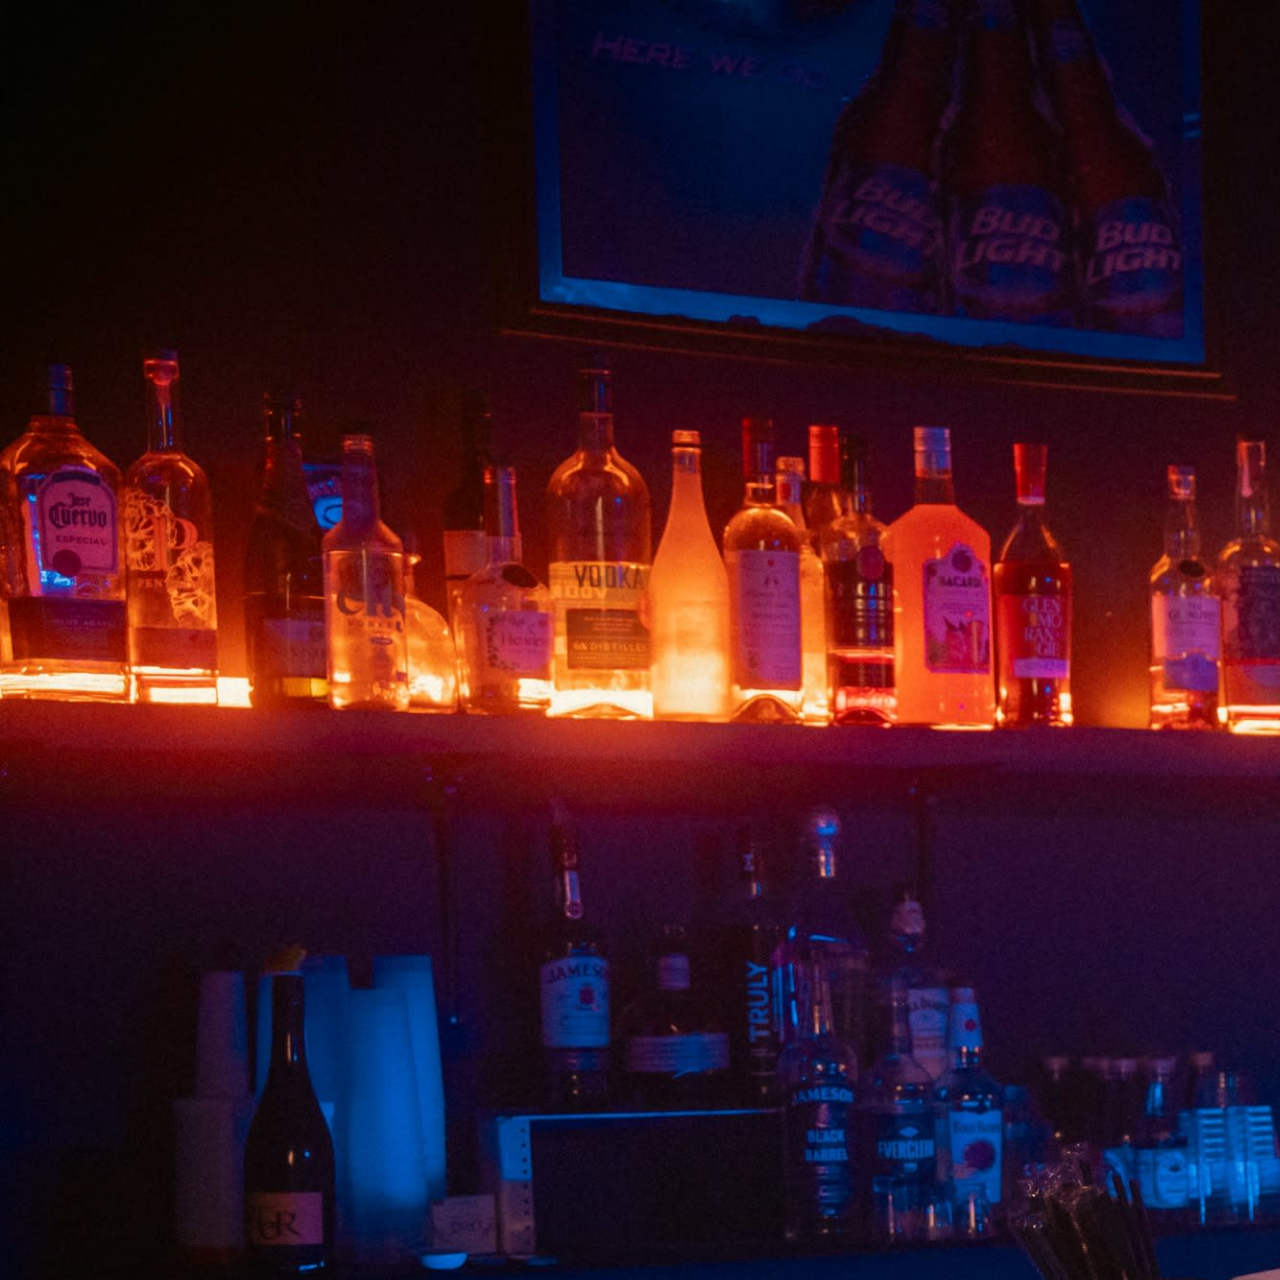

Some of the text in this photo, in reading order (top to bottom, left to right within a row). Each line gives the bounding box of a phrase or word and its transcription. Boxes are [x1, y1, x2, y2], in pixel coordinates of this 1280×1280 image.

[591, 29, 692, 72] HERE
[969, 207, 1059, 242] BUD
[1097, 221, 1174, 250] BUD
[48, 503, 108, 529] Cuervo
[55, 534, 107, 546] ESPECIAL
[573, 564, 646, 588] VODKA
[746, 960, 770, 1043] TRULY
